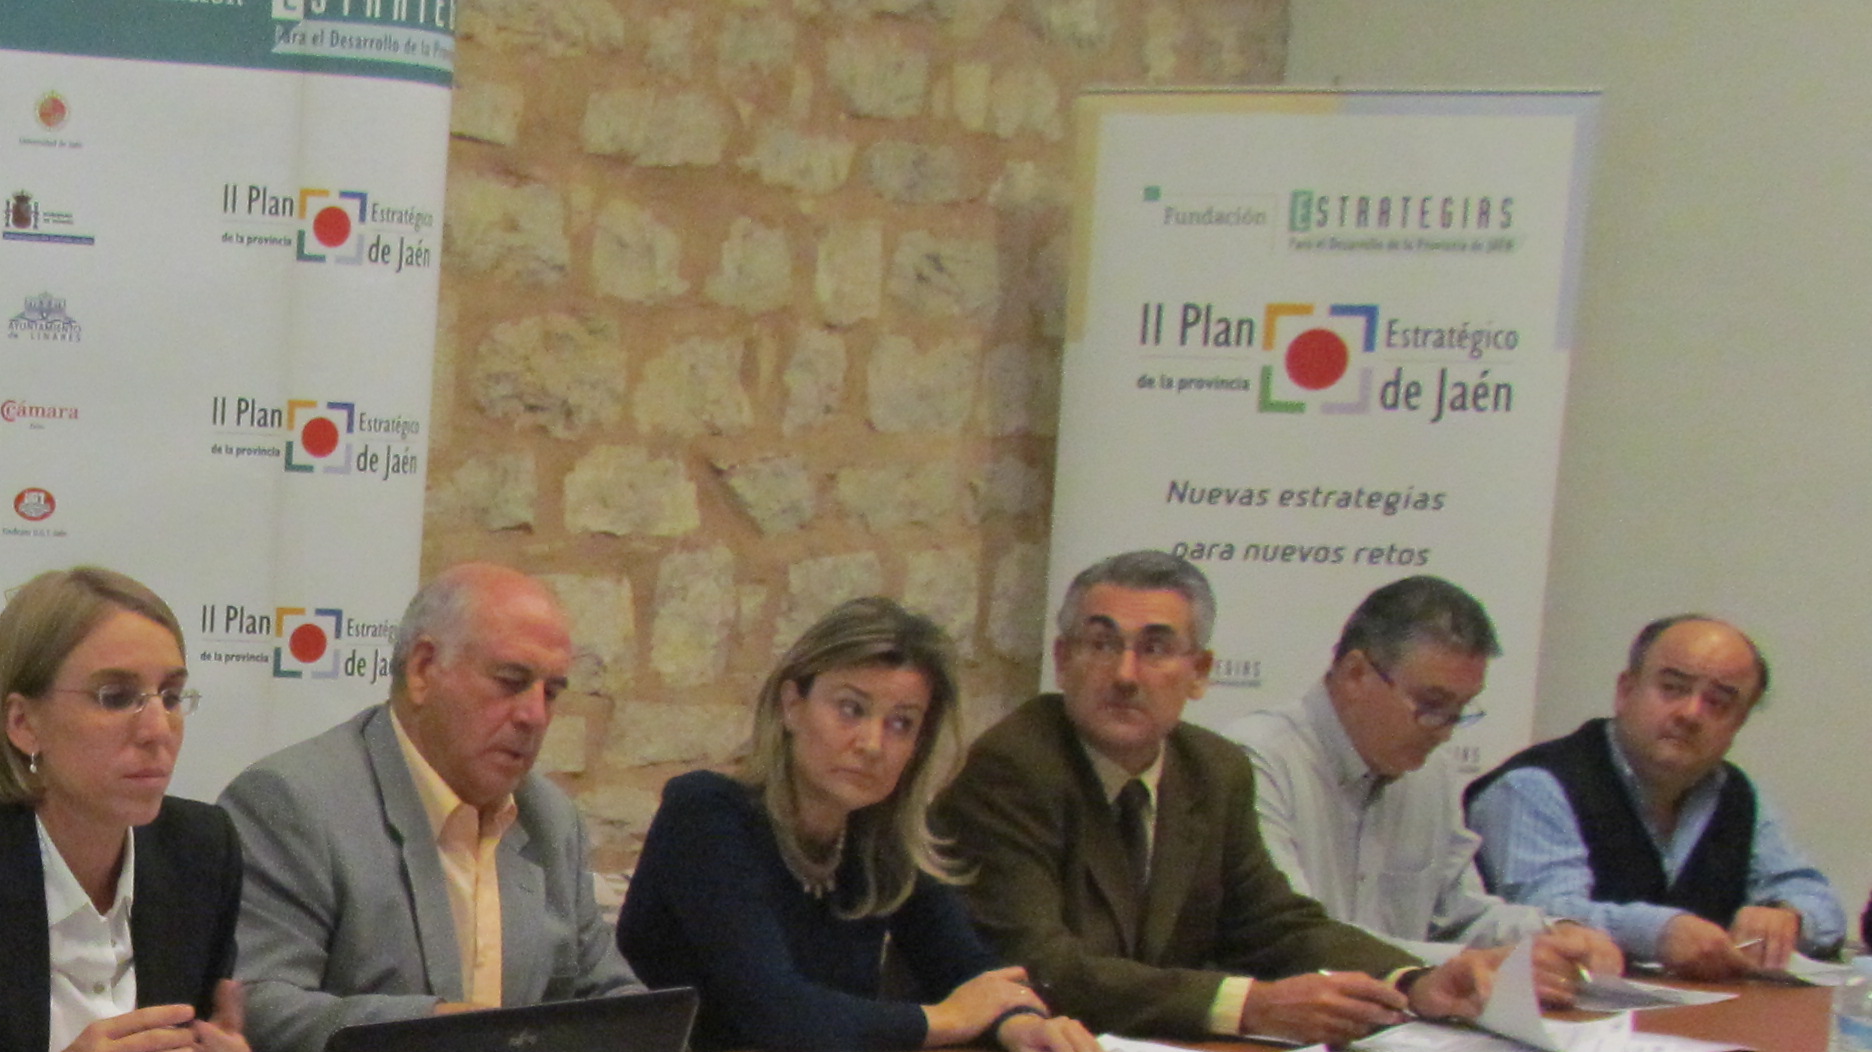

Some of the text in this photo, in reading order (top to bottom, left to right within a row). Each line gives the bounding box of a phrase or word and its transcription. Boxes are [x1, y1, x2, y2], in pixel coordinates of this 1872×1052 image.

[277, 24, 305, 46] Para
[312, 29, 326, 45] el
[330, 29, 399, 53] Desarrollo
[404, 38, 417, 55] de
[224, 184, 294, 217] II Plan
[1163, 190, 1516, 231] Fundación ESTRATEGIAS
[370, 203, 433, 232] Estratégico
[222, 232, 292, 249] de la provincia
[368, 236, 431, 273] de Jaén
[8, 319, 82, 333] AYUNTAMIENTO
[30, 332, 81, 342] LINARES
[1140, 304, 1255, 347] II Plan
[1385, 319, 1519, 359] Estratégico
[1137, 373, 1250, 397] de la provincia
[1380, 368, 1514, 423] de Jaén
[0, 400, 79, 422] Cámara
[213, 397, 282, 429] II Plan
[359, 413, 420, 438] Estratégico
[211, 443, 281, 459] de la provincia
[356, 446, 417, 481] de Jaén
[1166, 480, 1447, 516] Nuevas estrategias
[1171, 540, 1431, 567] para nuevos retos
[203, 605, 271, 636] II Plan
[346, 616, 395, 643] Estratég
[200, 650, 269, 664] de la provincia
[345, 649, 390, 685] de Ja
